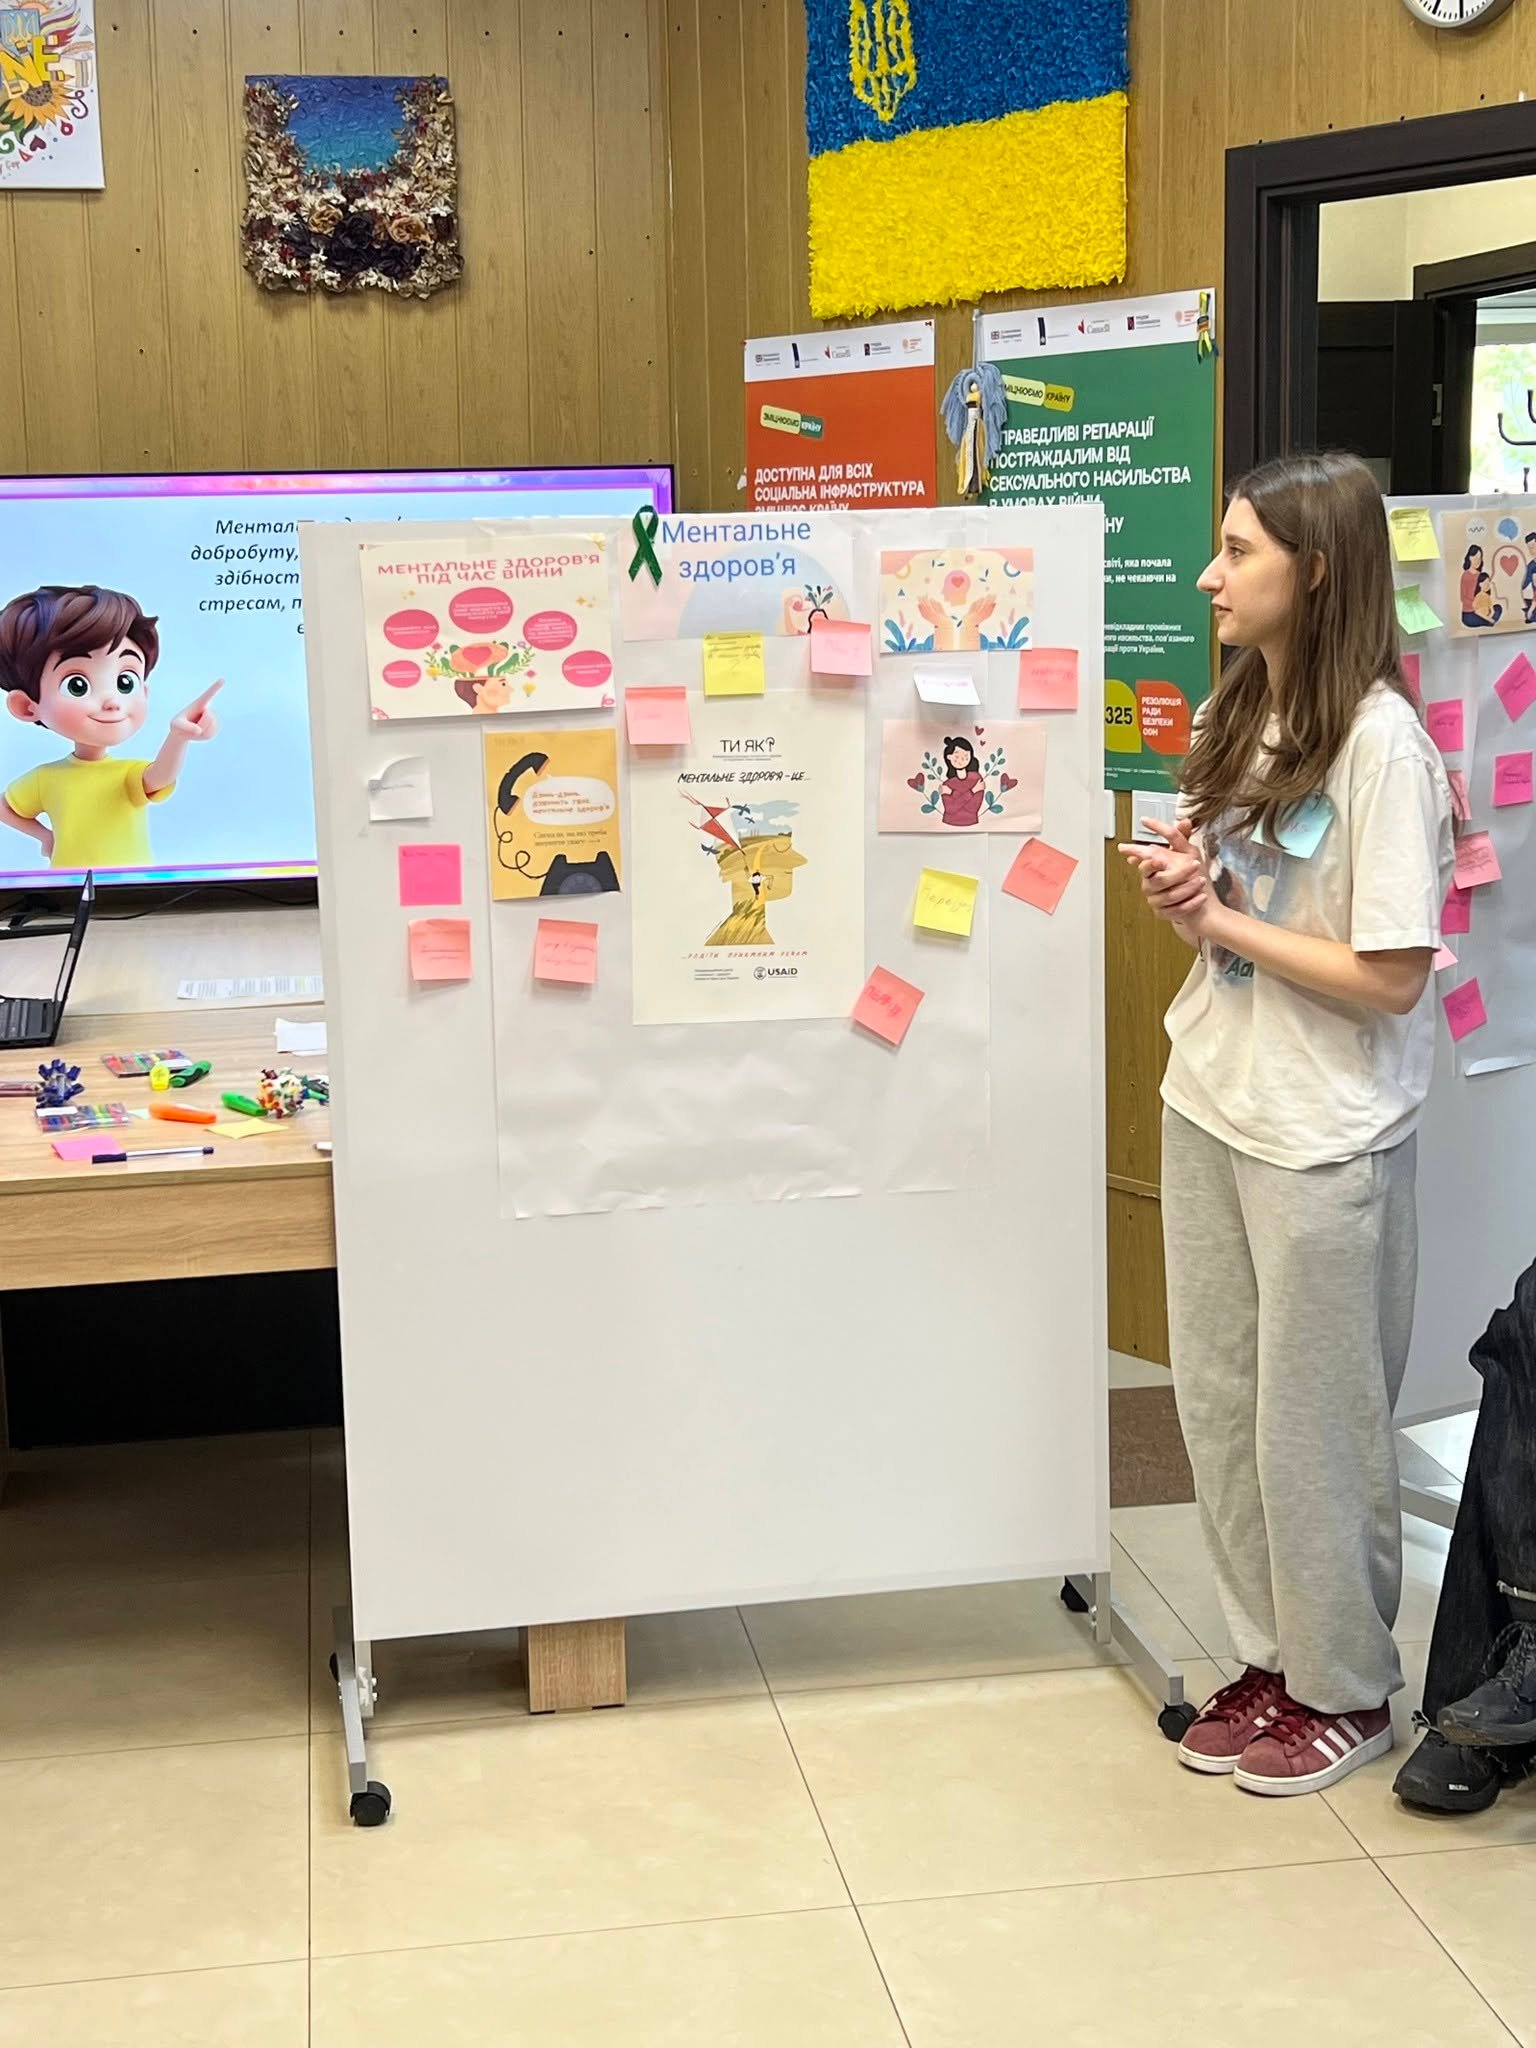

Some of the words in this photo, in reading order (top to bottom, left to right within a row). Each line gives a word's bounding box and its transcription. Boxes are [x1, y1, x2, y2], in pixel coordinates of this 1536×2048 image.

[1004, 384, 1043, 399] МІЦНЮЄМО
[1001, 425, 1079, 446] ПРАВЕДЛИВІ
[1083, 416, 1155, 441] РЕПАРАЦІЇ
[1107, 446, 1131, 464] ВІД
[755, 466, 815, 484] ДОСТУПНА
[818, 464, 843, 482] ДЛЯ
[846, 463, 873, 479] ВСІХ
[990, 471, 1090, 492] СЕКСУАЛЬНОГО
[1094, 466, 1191, 487] НАСИЛЬСТВА
[755, 485, 817, 503] СОЦІАЛЬНА
[820, 481, 926, 500] ІНФРАСТРУКТУРА
[662, 521, 811, 544] Ментальне
[191, 544, 299, 563] добробуту,
[378, 559, 497, 576] МЕНТАЛЬНЕ
[504, 554, 600, 572] ЗДОРОВ'Я
[679, 552, 796, 582] здоров'я
[1124, 558, 1140, 568] яка
[1141, 558, 1172, 568] почала
[417, 573, 452, 585] ПІД
[457, 571, 496, 582] ЧАС
[1115, 574, 1126, 583] не
[1127, 574, 1165, 583] чекаючи
[1166, 573, 1177, 583] на
[199, 598, 286, 613] стресам,
[1142, 707, 1162, 717] РАДИ
[1143, 728, 1159, 736] ООН
[720, 739, 740, 752] ТИ
[677, 772, 735, 784] МЕНТАЛЬНЕ
[767, 967, 798, 976] USAID
